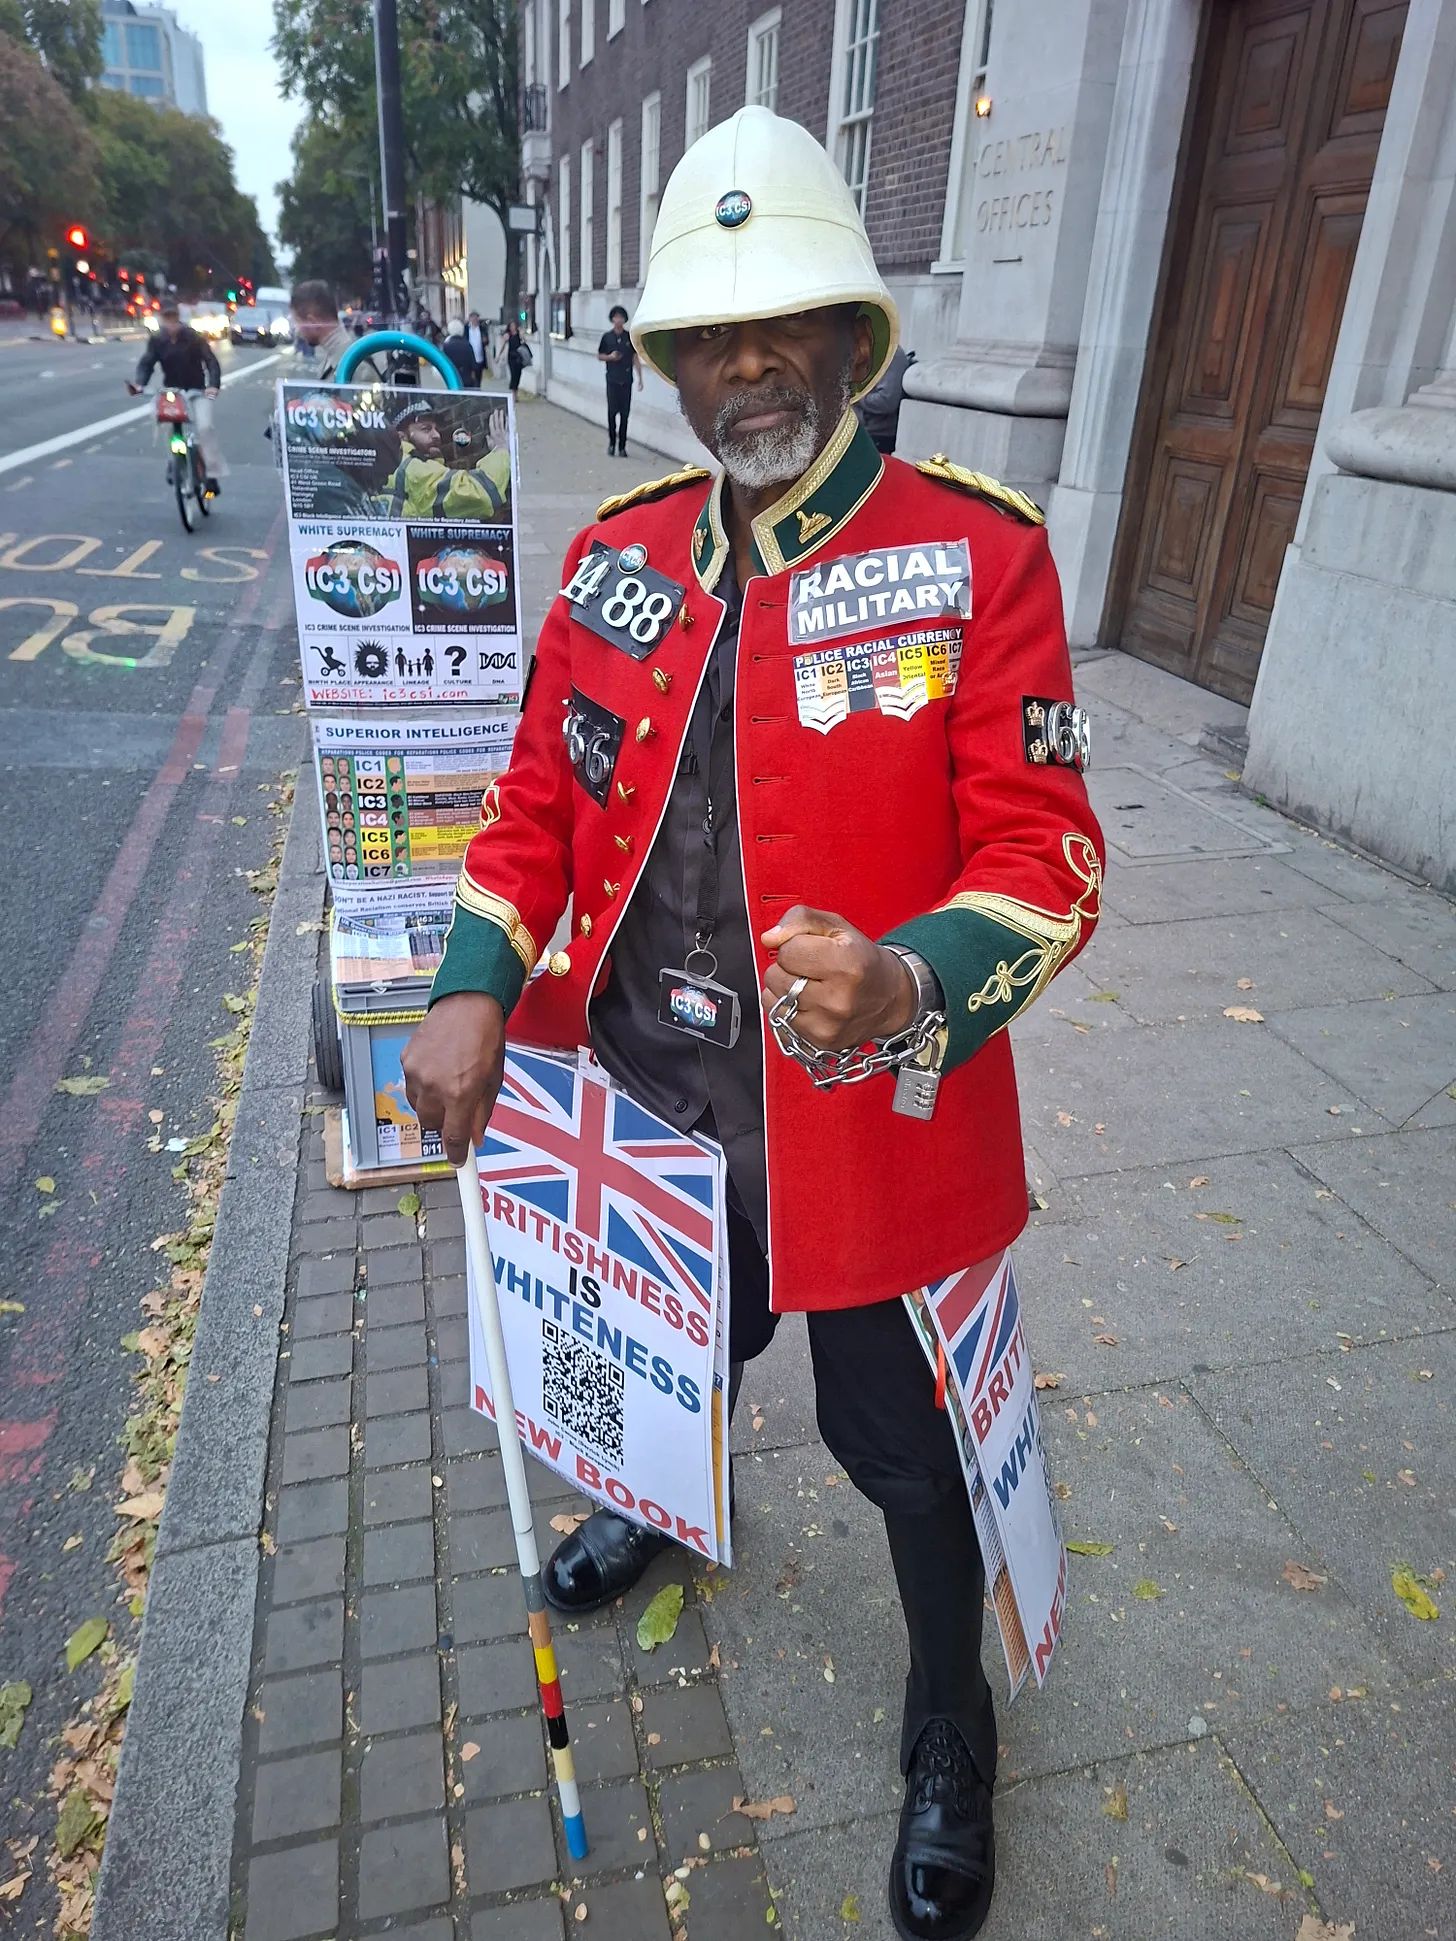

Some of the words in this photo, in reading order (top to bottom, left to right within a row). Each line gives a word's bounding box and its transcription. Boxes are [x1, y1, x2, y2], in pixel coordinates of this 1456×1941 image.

[979, 127, 1066, 178] CENTRAL
[716, 204, 732, 217] IC3
[977, 189, 1054, 233] OFFICES
[288, 405, 319, 428] IC3
[360, 411, 386, 430] UK
[298, 525, 334, 536] WHITE
[337, 526, 402, 538] SUPREMACY
[410, 528, 445, 539] WHITE
[447, 529, 510, 540] SUPREMACY
[0, 532, 269, 583] STO
[307, 565, 350, 594] IC3
[357, 564, 400, 594] CSI
[419, 567, 459, 596] IC3
[466, 568, 506, 596] CSI
[796, 549, 963, 605] RACIAL
[558, 553, 610, 607] 14
[602, 577, 673, 643] 88
[797, 581, 964, 636] MILITARY
[362, 624, 410, 632] INVESTIGATION
[447, 625, 468, 633] SCENE
[469, 625, 516, 633] INVESTIGATION
[795, 648, 843, 668] POLICE
[846, 639, 895, 658] RACIAL
[897, 628, 962, 647] CURRENCY
[900, 647, 923, 661] IC5
[926, 643, 947, 657] IC6
[949, 641, 962, 654] IC7
[846, 657, 870, 672] IC3
[872, 651, 897, 667] IC4
[797, 667, 817, 681] IC1
[821, 663, 844, 677] IC2
[875, 669, 898, 679] Asian
[312, 688, 373, 700] WEBSITE:
[823, 689, 847, 697] European
[848, 684, 874, 693] Caribbean
[326, 727, 401, 739] SUPERIOR
[406, 723, 509, 739] INTELLIGENCE
[356, 760, 382, 772] IC1
[357, 778, 385, 789] IC2
[358, 795, 387, 808] IC3
[360, 813, 388, 826] IC4
[362, 832, 389, 842] IC5
[363, 849, 390, 859] IC6
[364, 865, 391, 877] IC7
[377, 894, 396, 902] NAZI
[671, 993, 692, 1014] IC3
[694, 1002, 717, 1022] CSI
[379, 1126, 397, 1134] IC1
[400, 1123, 419, 1132] IC2
[422, 1143, 442, 1156] 9/11
[568, 1266, 602, 1309] IS
[993, 1382, 1038, 1511] WHI
[576, 1453, 711, 1556] BOOK
